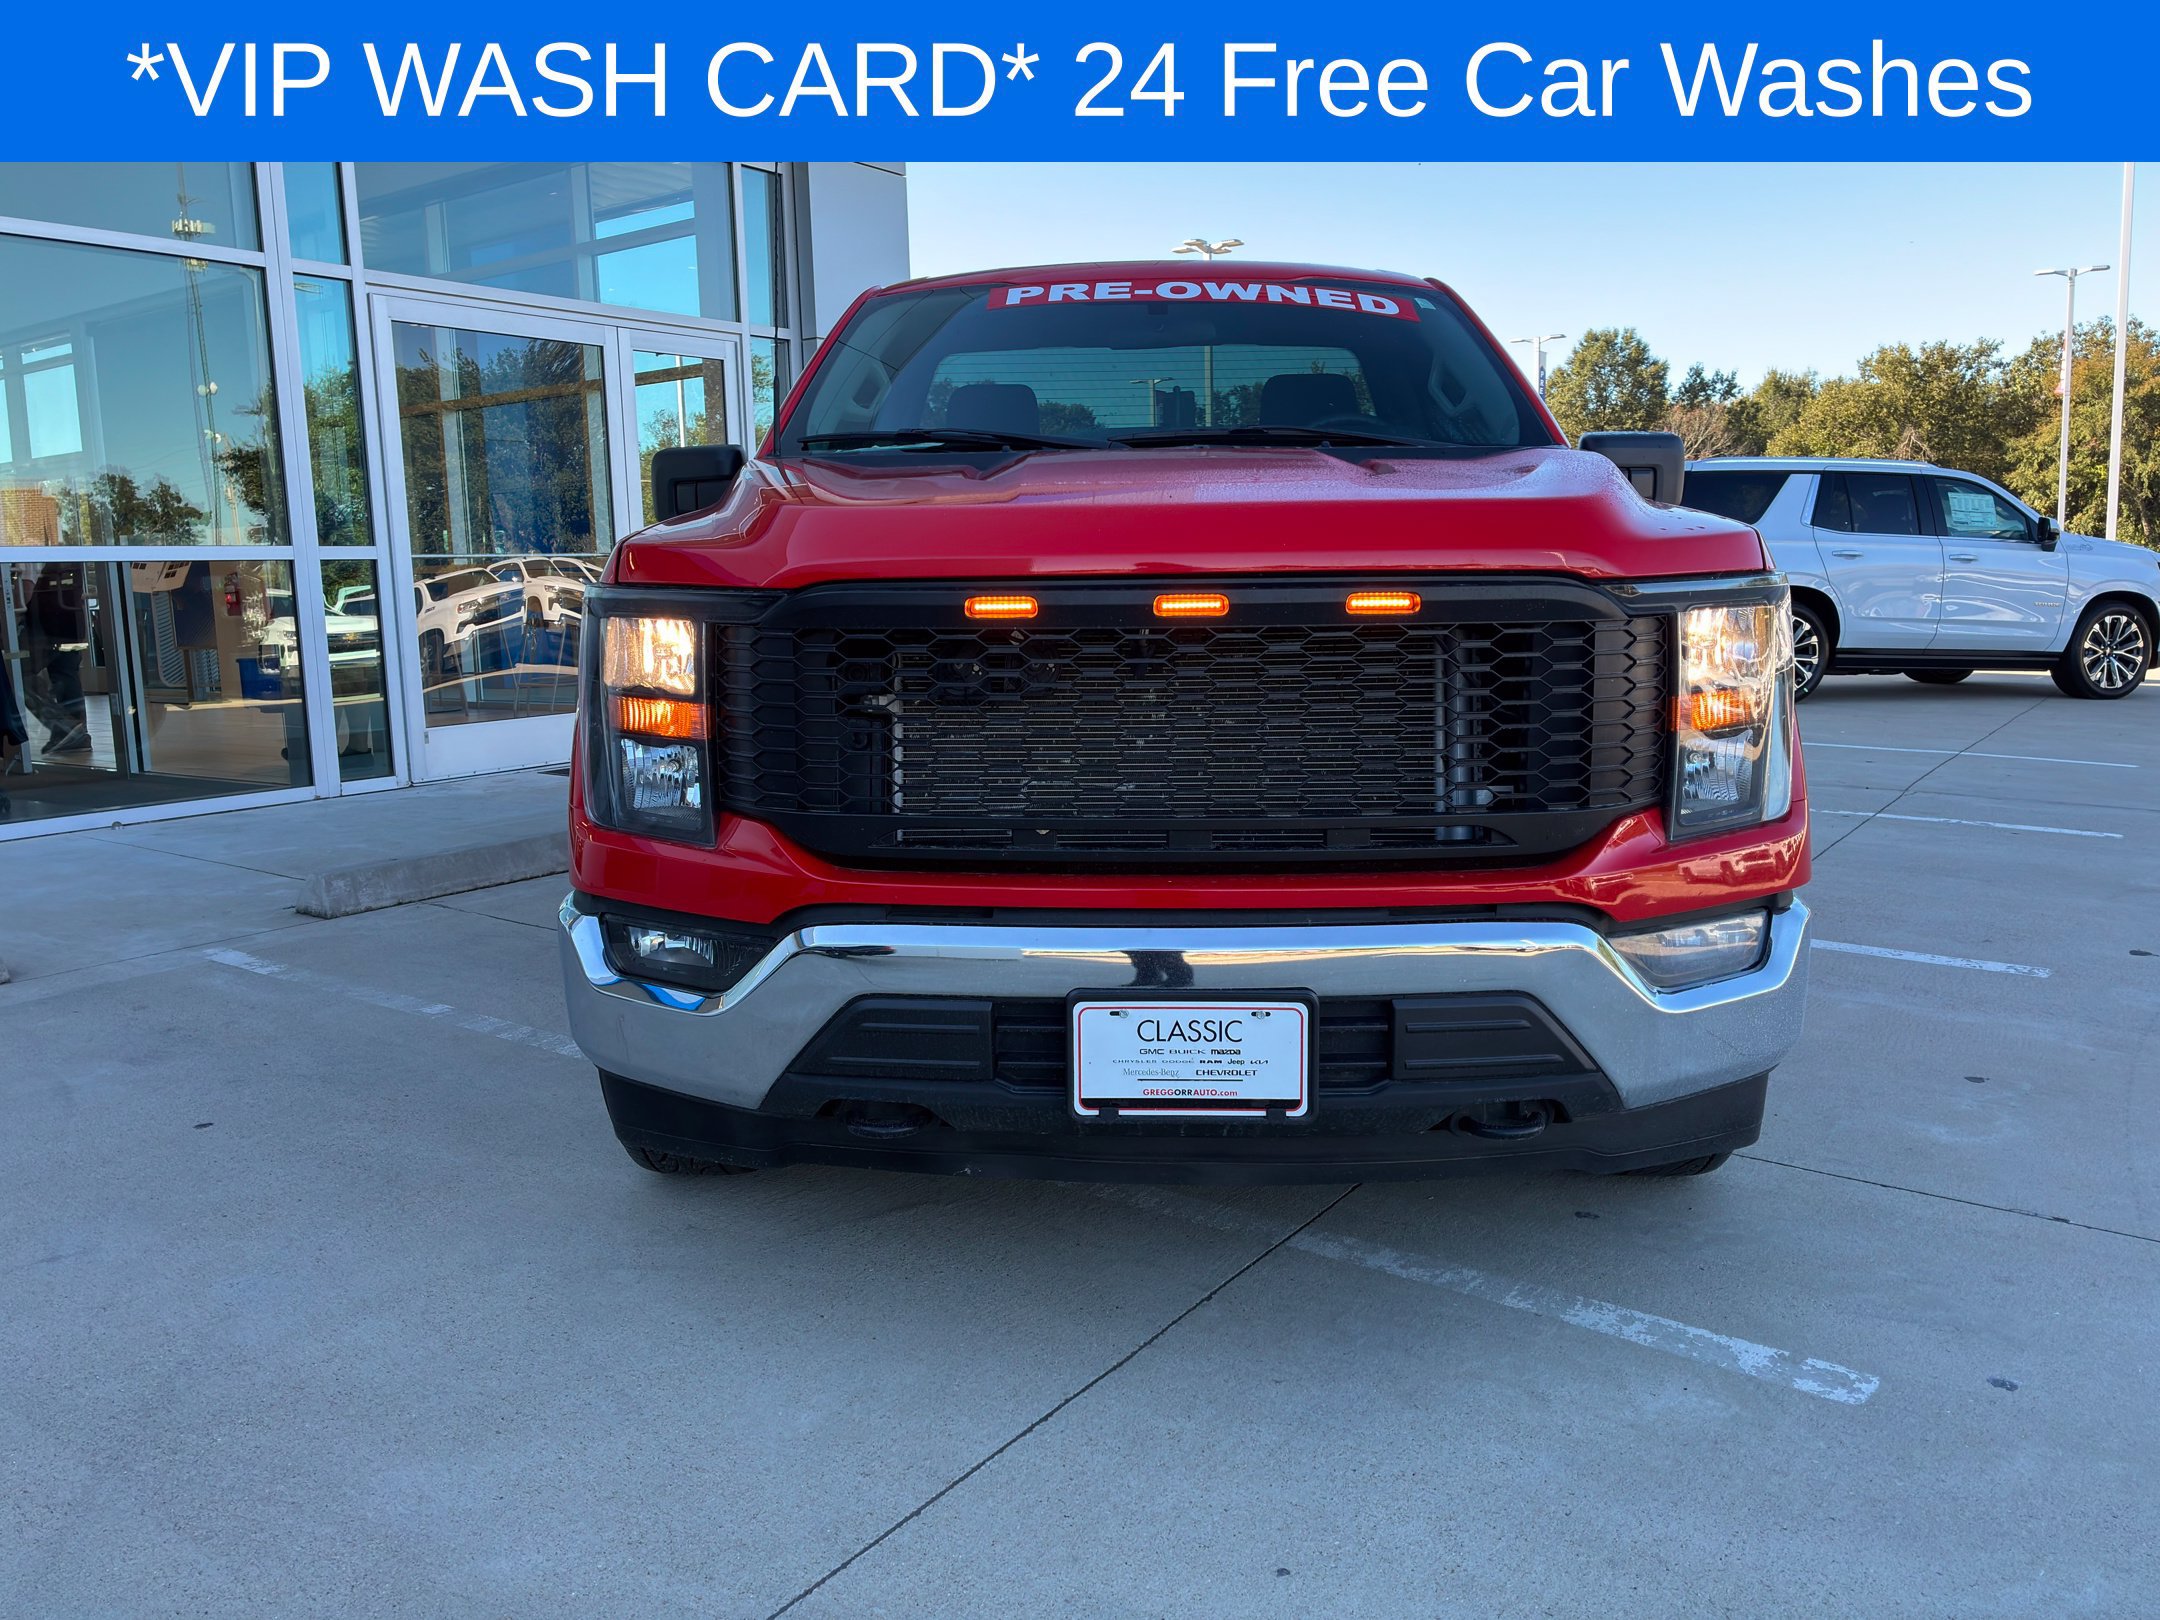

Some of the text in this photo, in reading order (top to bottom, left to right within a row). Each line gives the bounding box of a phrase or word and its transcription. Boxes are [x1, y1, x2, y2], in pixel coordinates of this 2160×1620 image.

[1004, 280, 1401, 317] PRE-OWNED
[1137, 1019, 1243, 1043] CLASSIC
[1227, 1058, 1245, 1066] Jeep
[1123, 1068, 1180, 1078] Mercedes-Benz
[1143, 1088, 1238, 1097] GREGGORRAUTO.com
